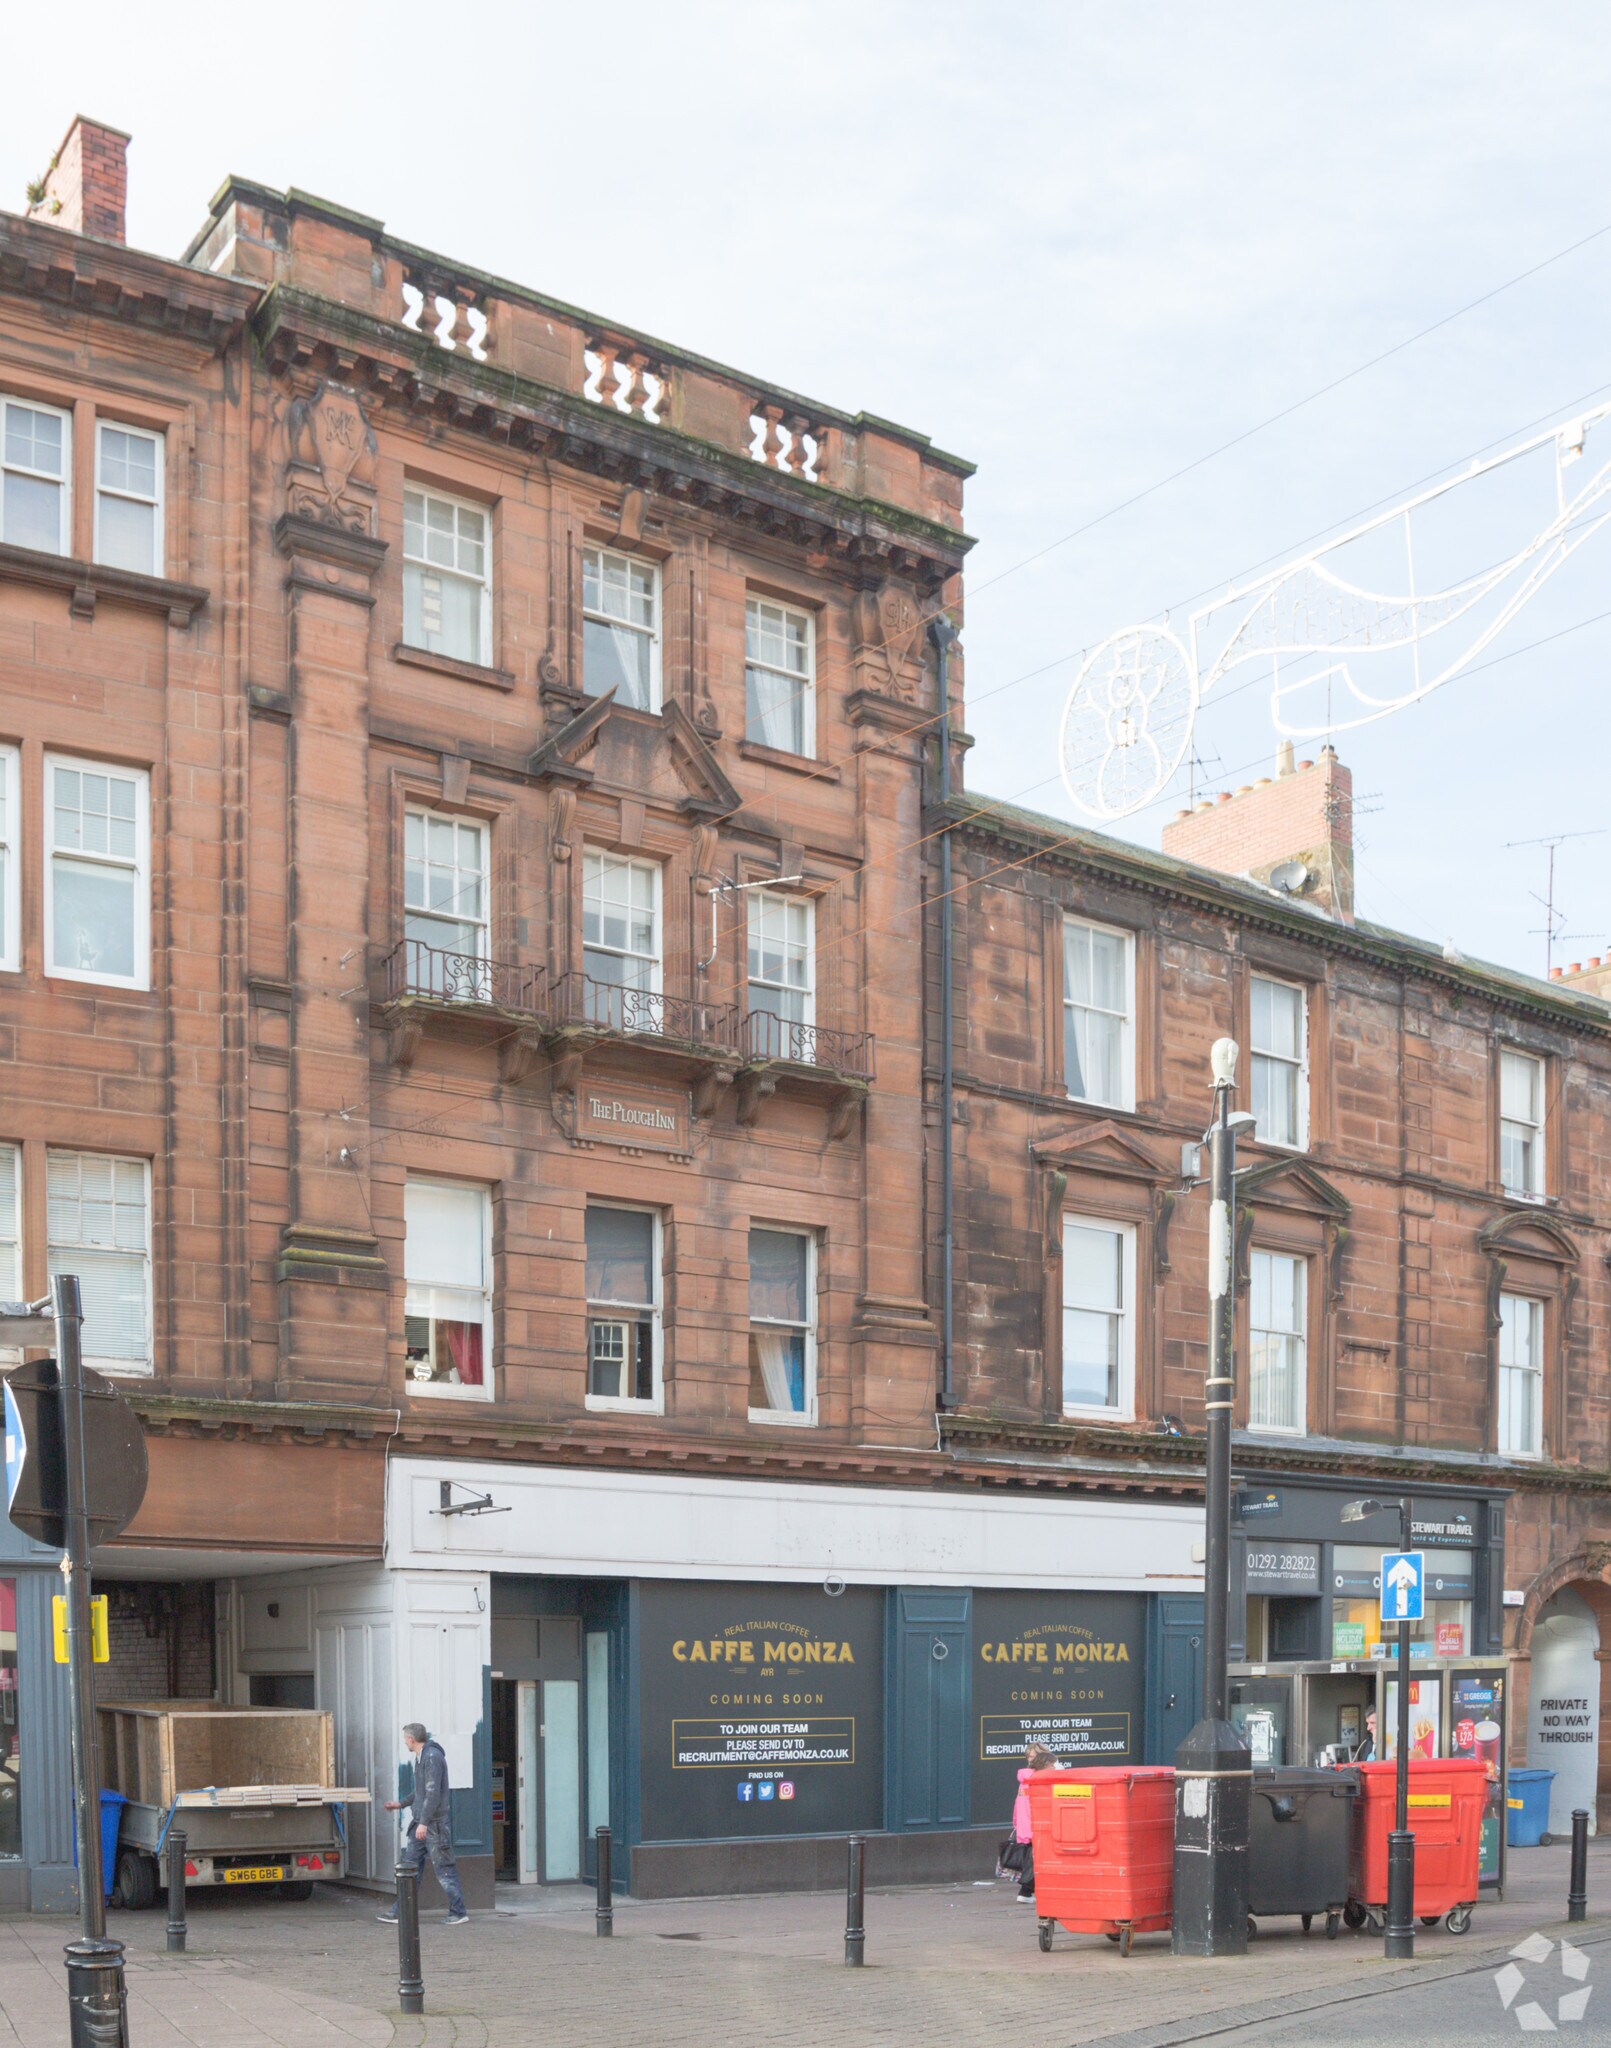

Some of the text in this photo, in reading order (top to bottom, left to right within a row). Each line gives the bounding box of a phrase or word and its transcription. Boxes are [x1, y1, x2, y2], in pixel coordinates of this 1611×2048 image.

[612, 1101, 655, 1127] PLOUGH
[656, 1109, 675, 1130] INN
[1242, 1503, 1262, 1512] STEWART
[1411, 1522, 1473, 1535] STEWART TRAVEL
[1248, 1554, 1316, 1570] 01292 282822
[1247, 1570, 1316, 1579] www.stewarttravel.co.uk
[724, 1621, 810, 1638] REAL ITALIAN COFFEE
[1024, 1625, 1094, 1640] REAL ITALIAN COFFEE
[672, 1640, 855, 1664] CAFFE MONZA
[981, 1642, 1130, 1662] CAFFE MONZA
[760, 1668, 774, 1676] AYR
[710, 1694, 824, 1704] COMING SOON
[1012, 1690, 1104, 1700] COMING SOON
[1470, 1692, 1492, 1700] GREGGS
[1540, 1699, 1588, 1710] PRIVATE
[1020, 1718, 1092, 1728] TO JOIN OUR TEAM
[1544, 1715, 1591, 1726] NO WAY
[720, 1724, 808, 1734] TO JOIN OUR TEAM
[1025, 1732, 1088, 1743] PLEASE SEND CV TO
[1538, 1732, 1593, 1742] THROUGH
[726, 1739, 804, 1750] PLEASE SEND CV TO
[986, 1741, 1124, 1754] RECRUITMCAFFEMONZA.CO.UK
[679, 1749, 848, 1762] RECRUITMENT@CAFFEMONZA.CO.UK
[230, 1868, 279, 1880] SW66 GBE
